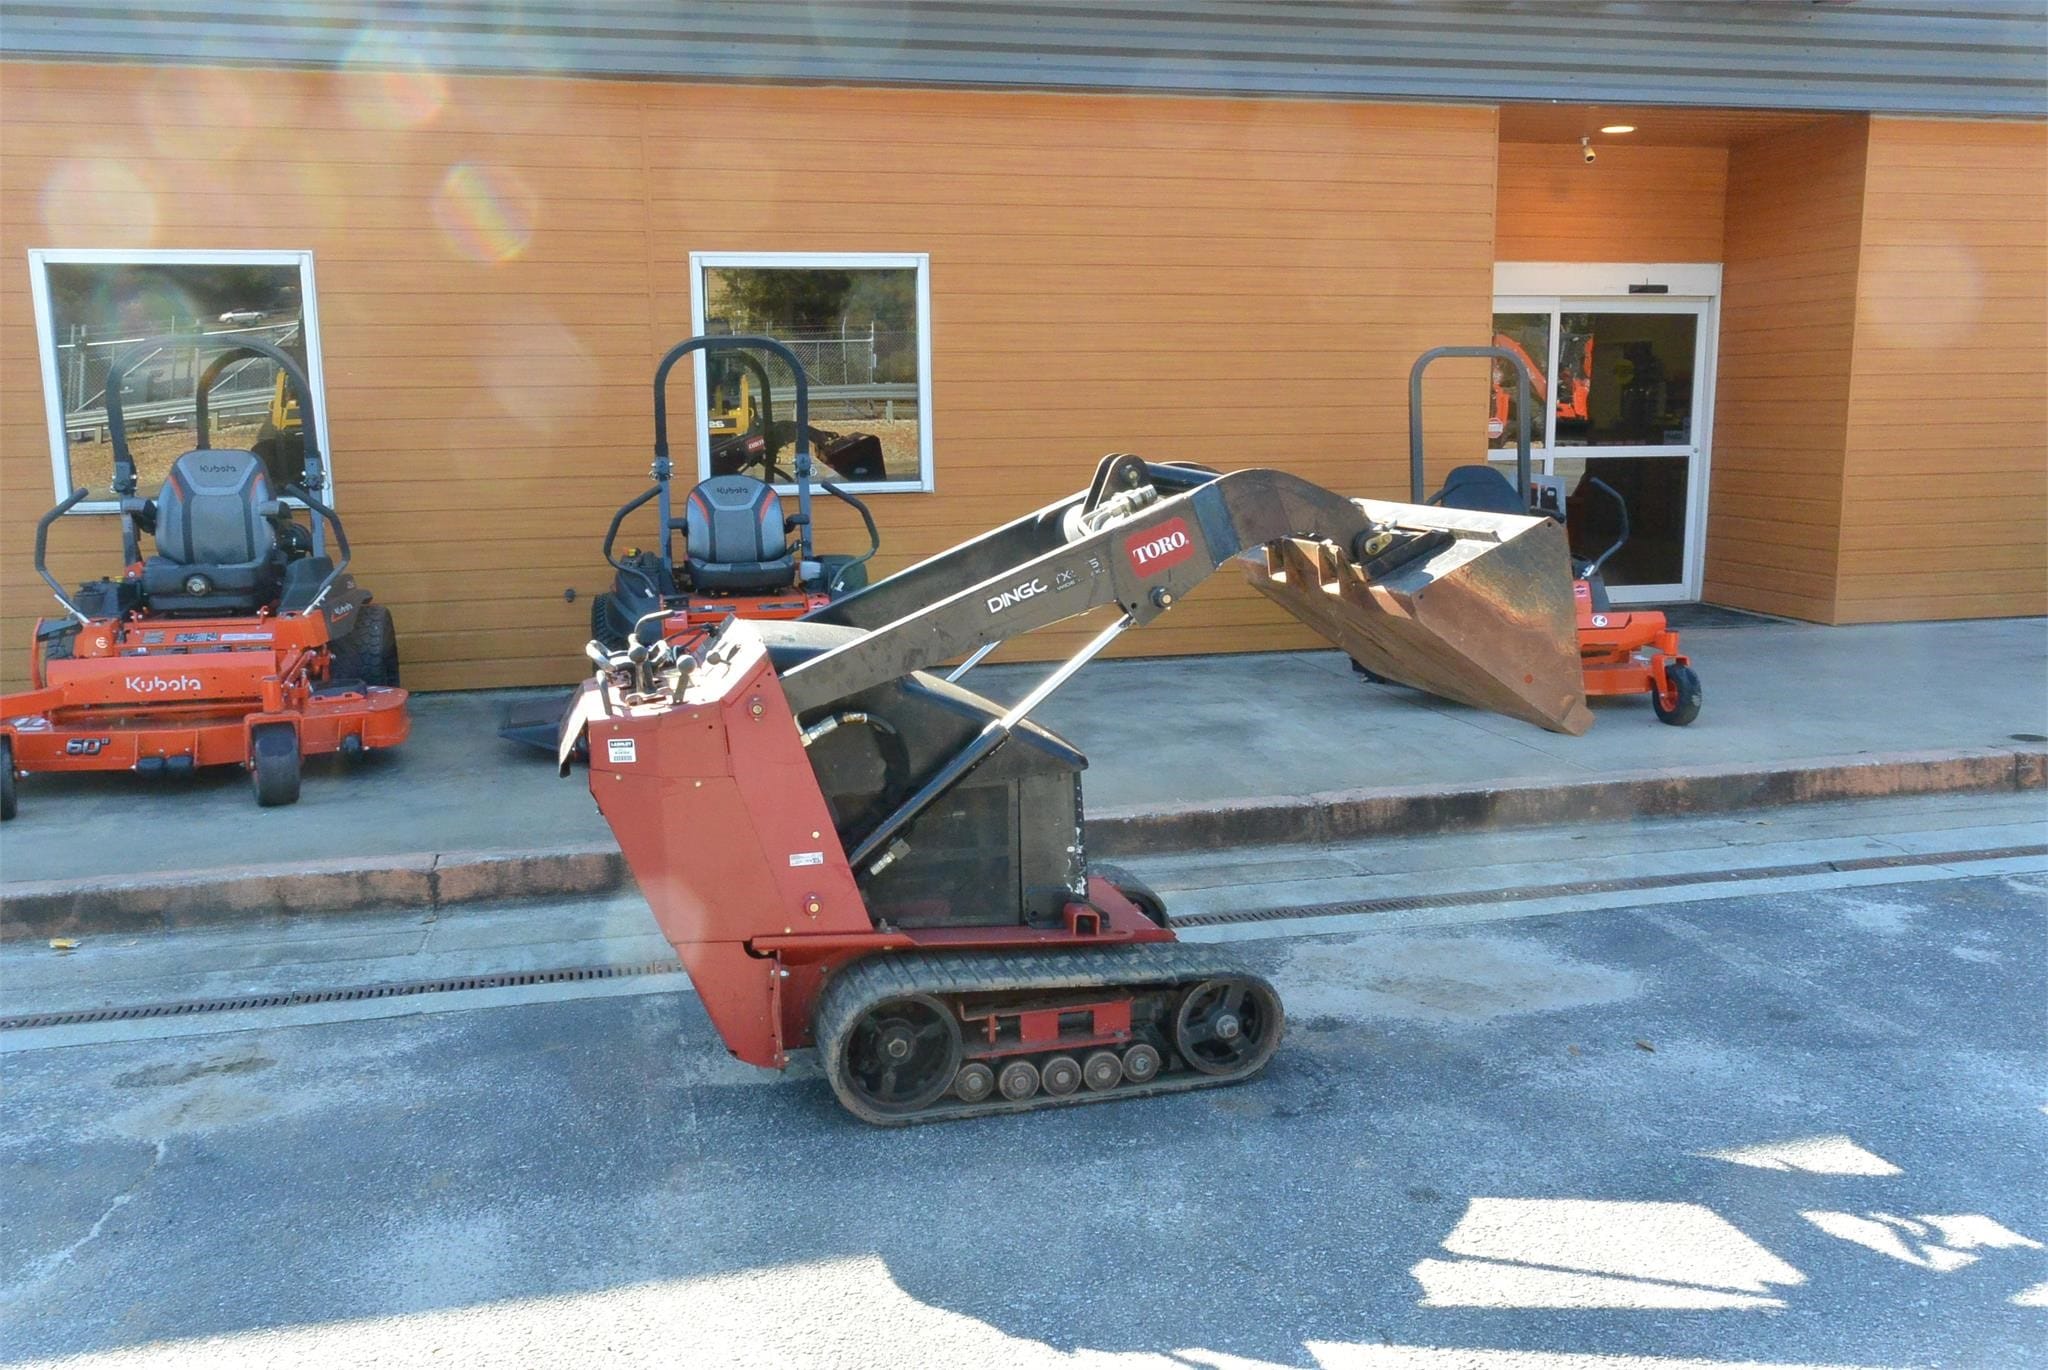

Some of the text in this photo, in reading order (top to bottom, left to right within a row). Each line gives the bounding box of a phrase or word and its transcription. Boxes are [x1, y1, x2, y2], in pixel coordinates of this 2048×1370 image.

[200, 464, 237, 473] Kubota
[1132, 531, 1186, 565] TORO
[125, 675, 202, 692] Kubota
